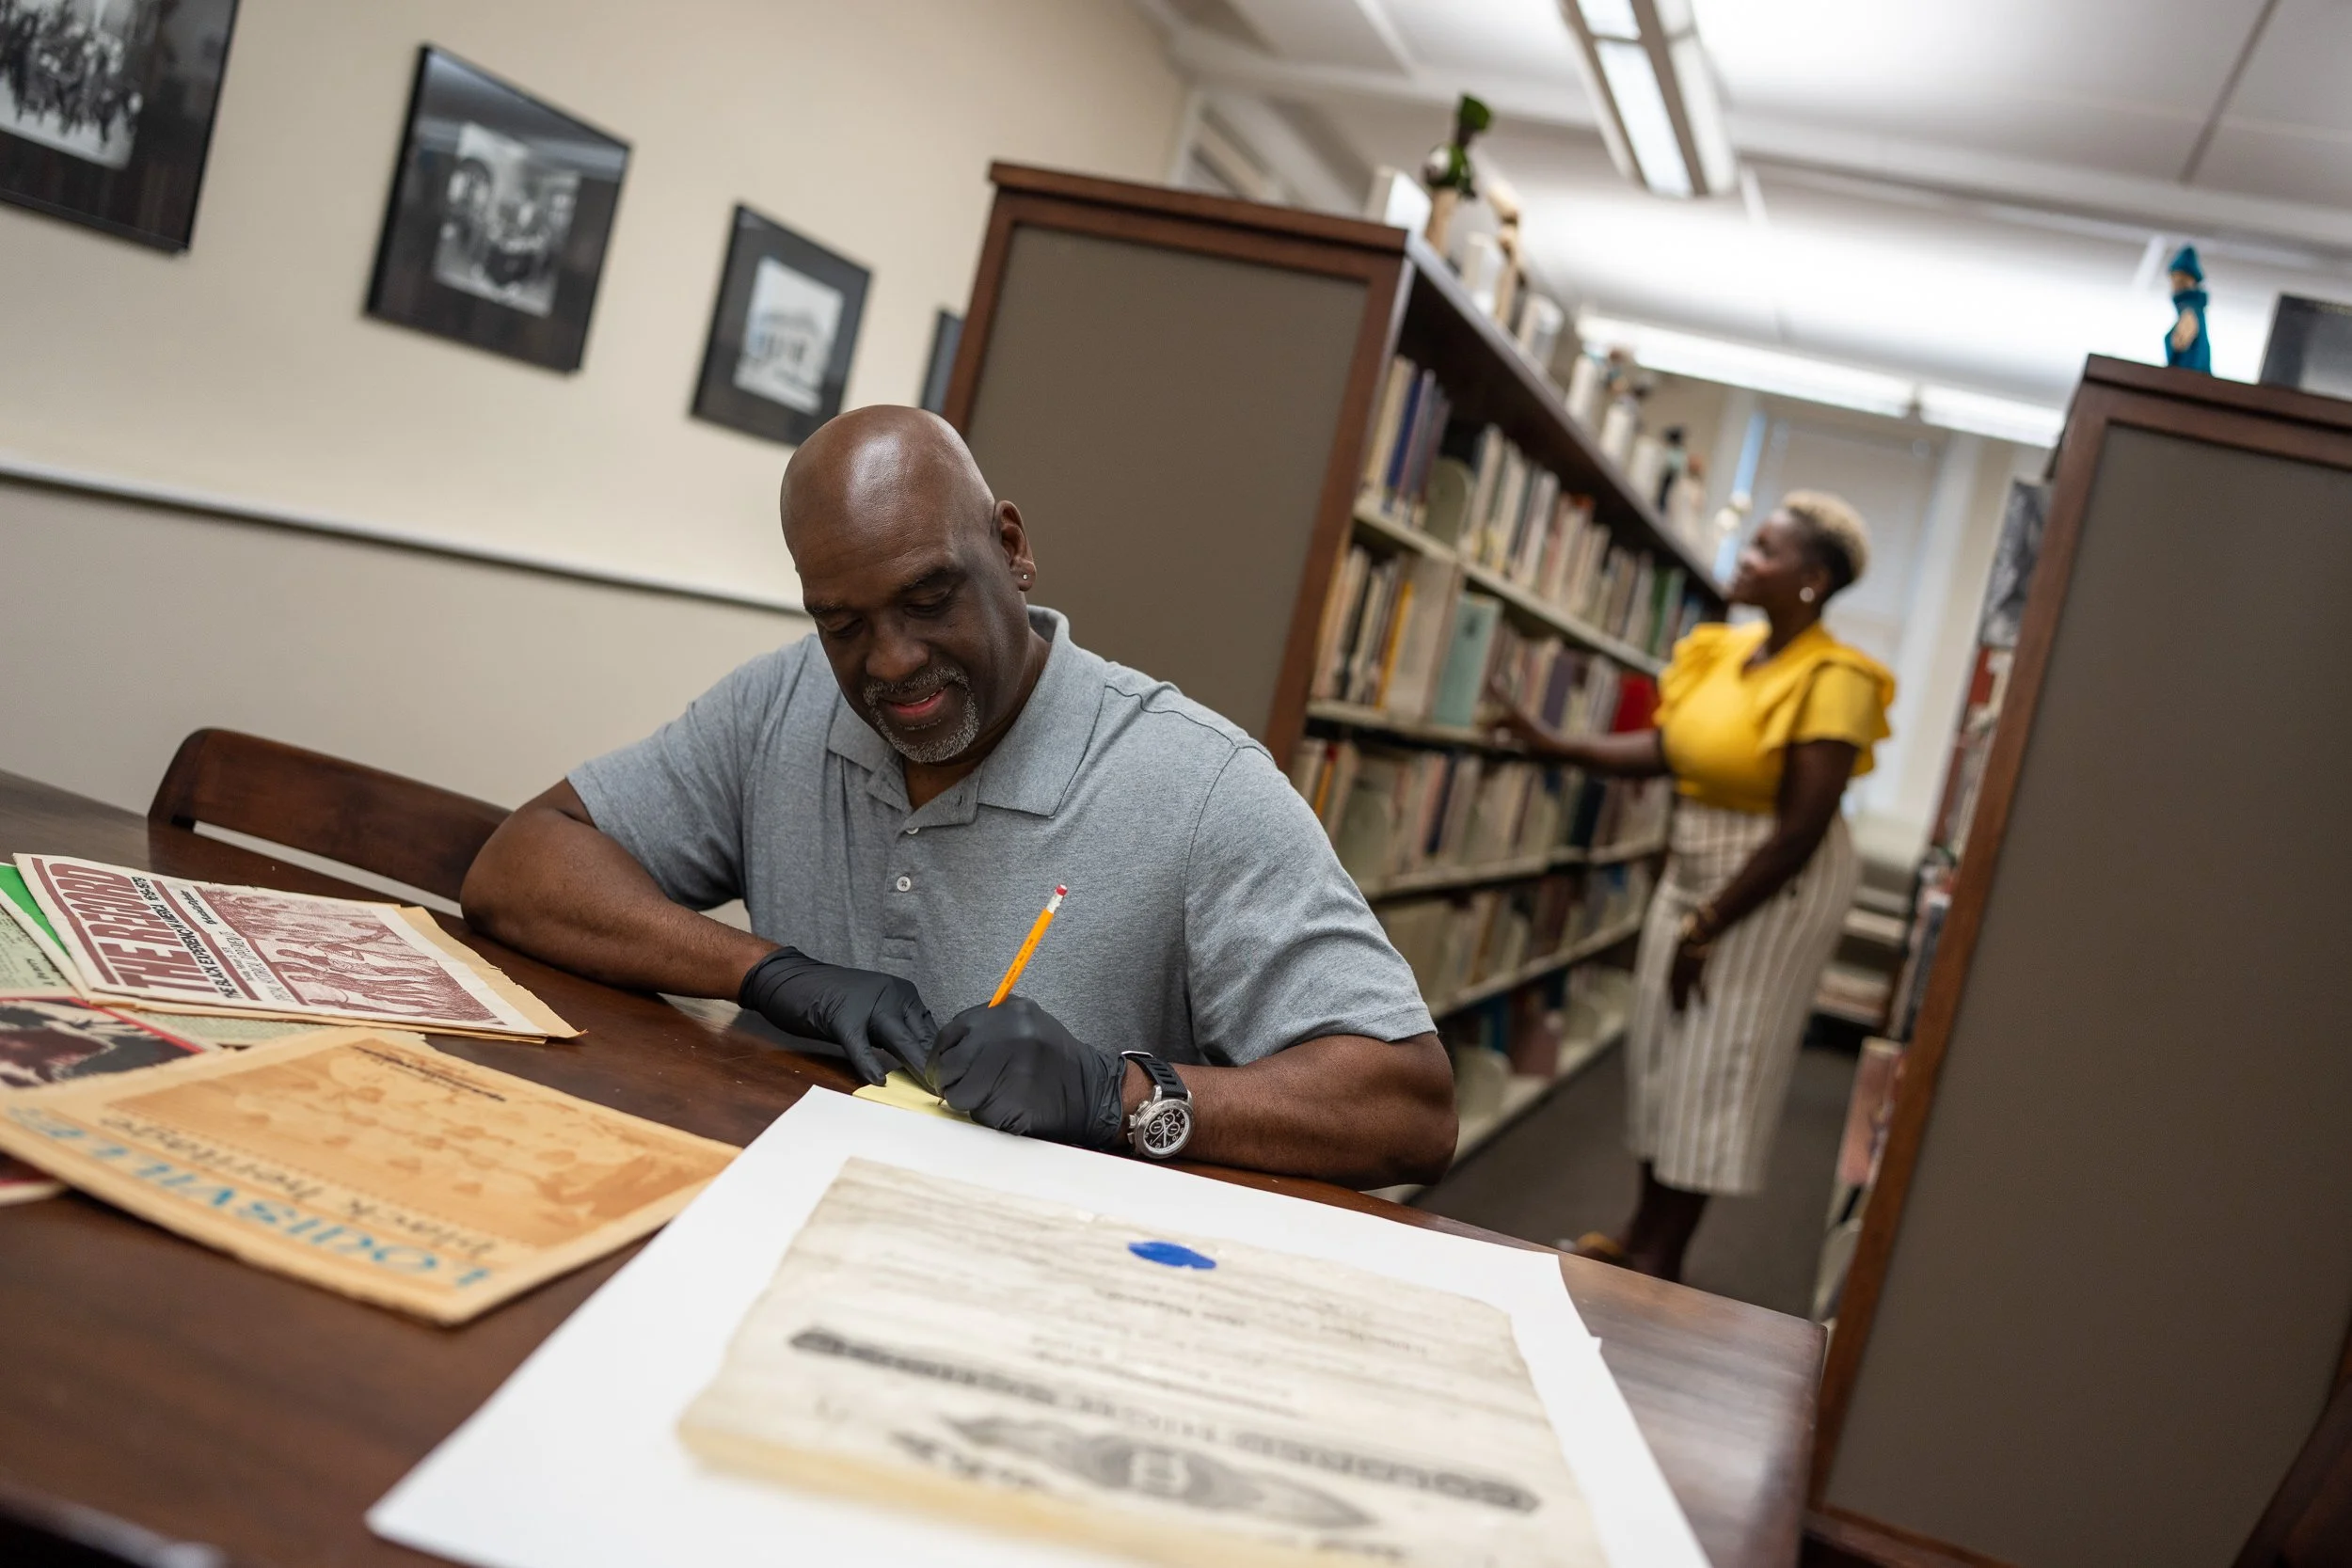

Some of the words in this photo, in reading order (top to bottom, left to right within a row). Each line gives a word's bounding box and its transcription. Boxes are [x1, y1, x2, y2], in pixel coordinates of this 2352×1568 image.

[49, 863, 185, 947] RECORD
[151, 904, 181, 924] AMERICA
[98, 942, 218, 993] THE
[201, 965, 233, 987] BLACK
